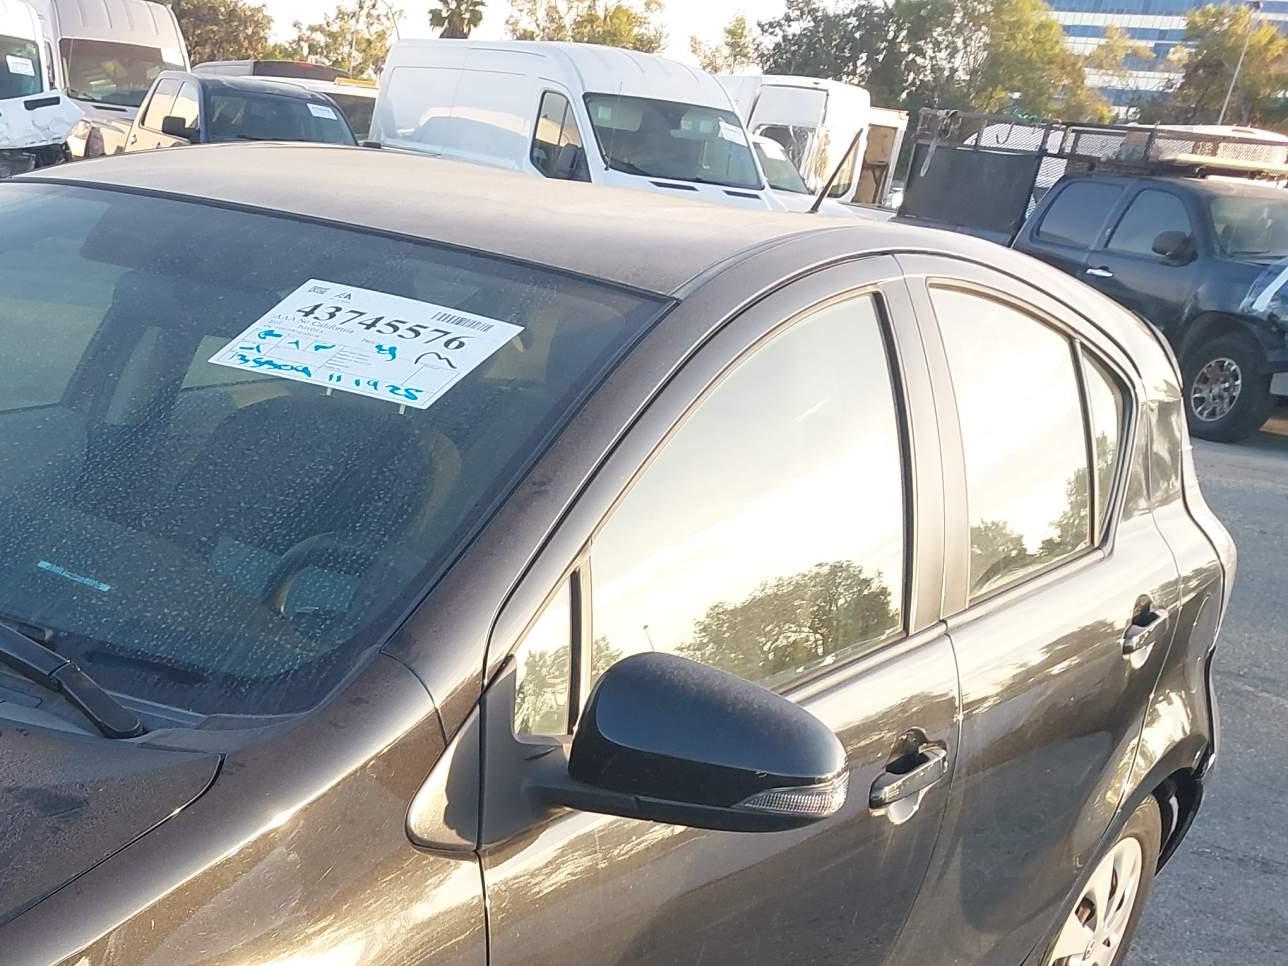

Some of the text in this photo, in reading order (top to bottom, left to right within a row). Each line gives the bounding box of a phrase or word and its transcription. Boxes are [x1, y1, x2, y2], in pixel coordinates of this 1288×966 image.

[296, 302, 472, 352] 43745576
[311, 321, 355, 335] California
[384, 384, 425, 401] 25
